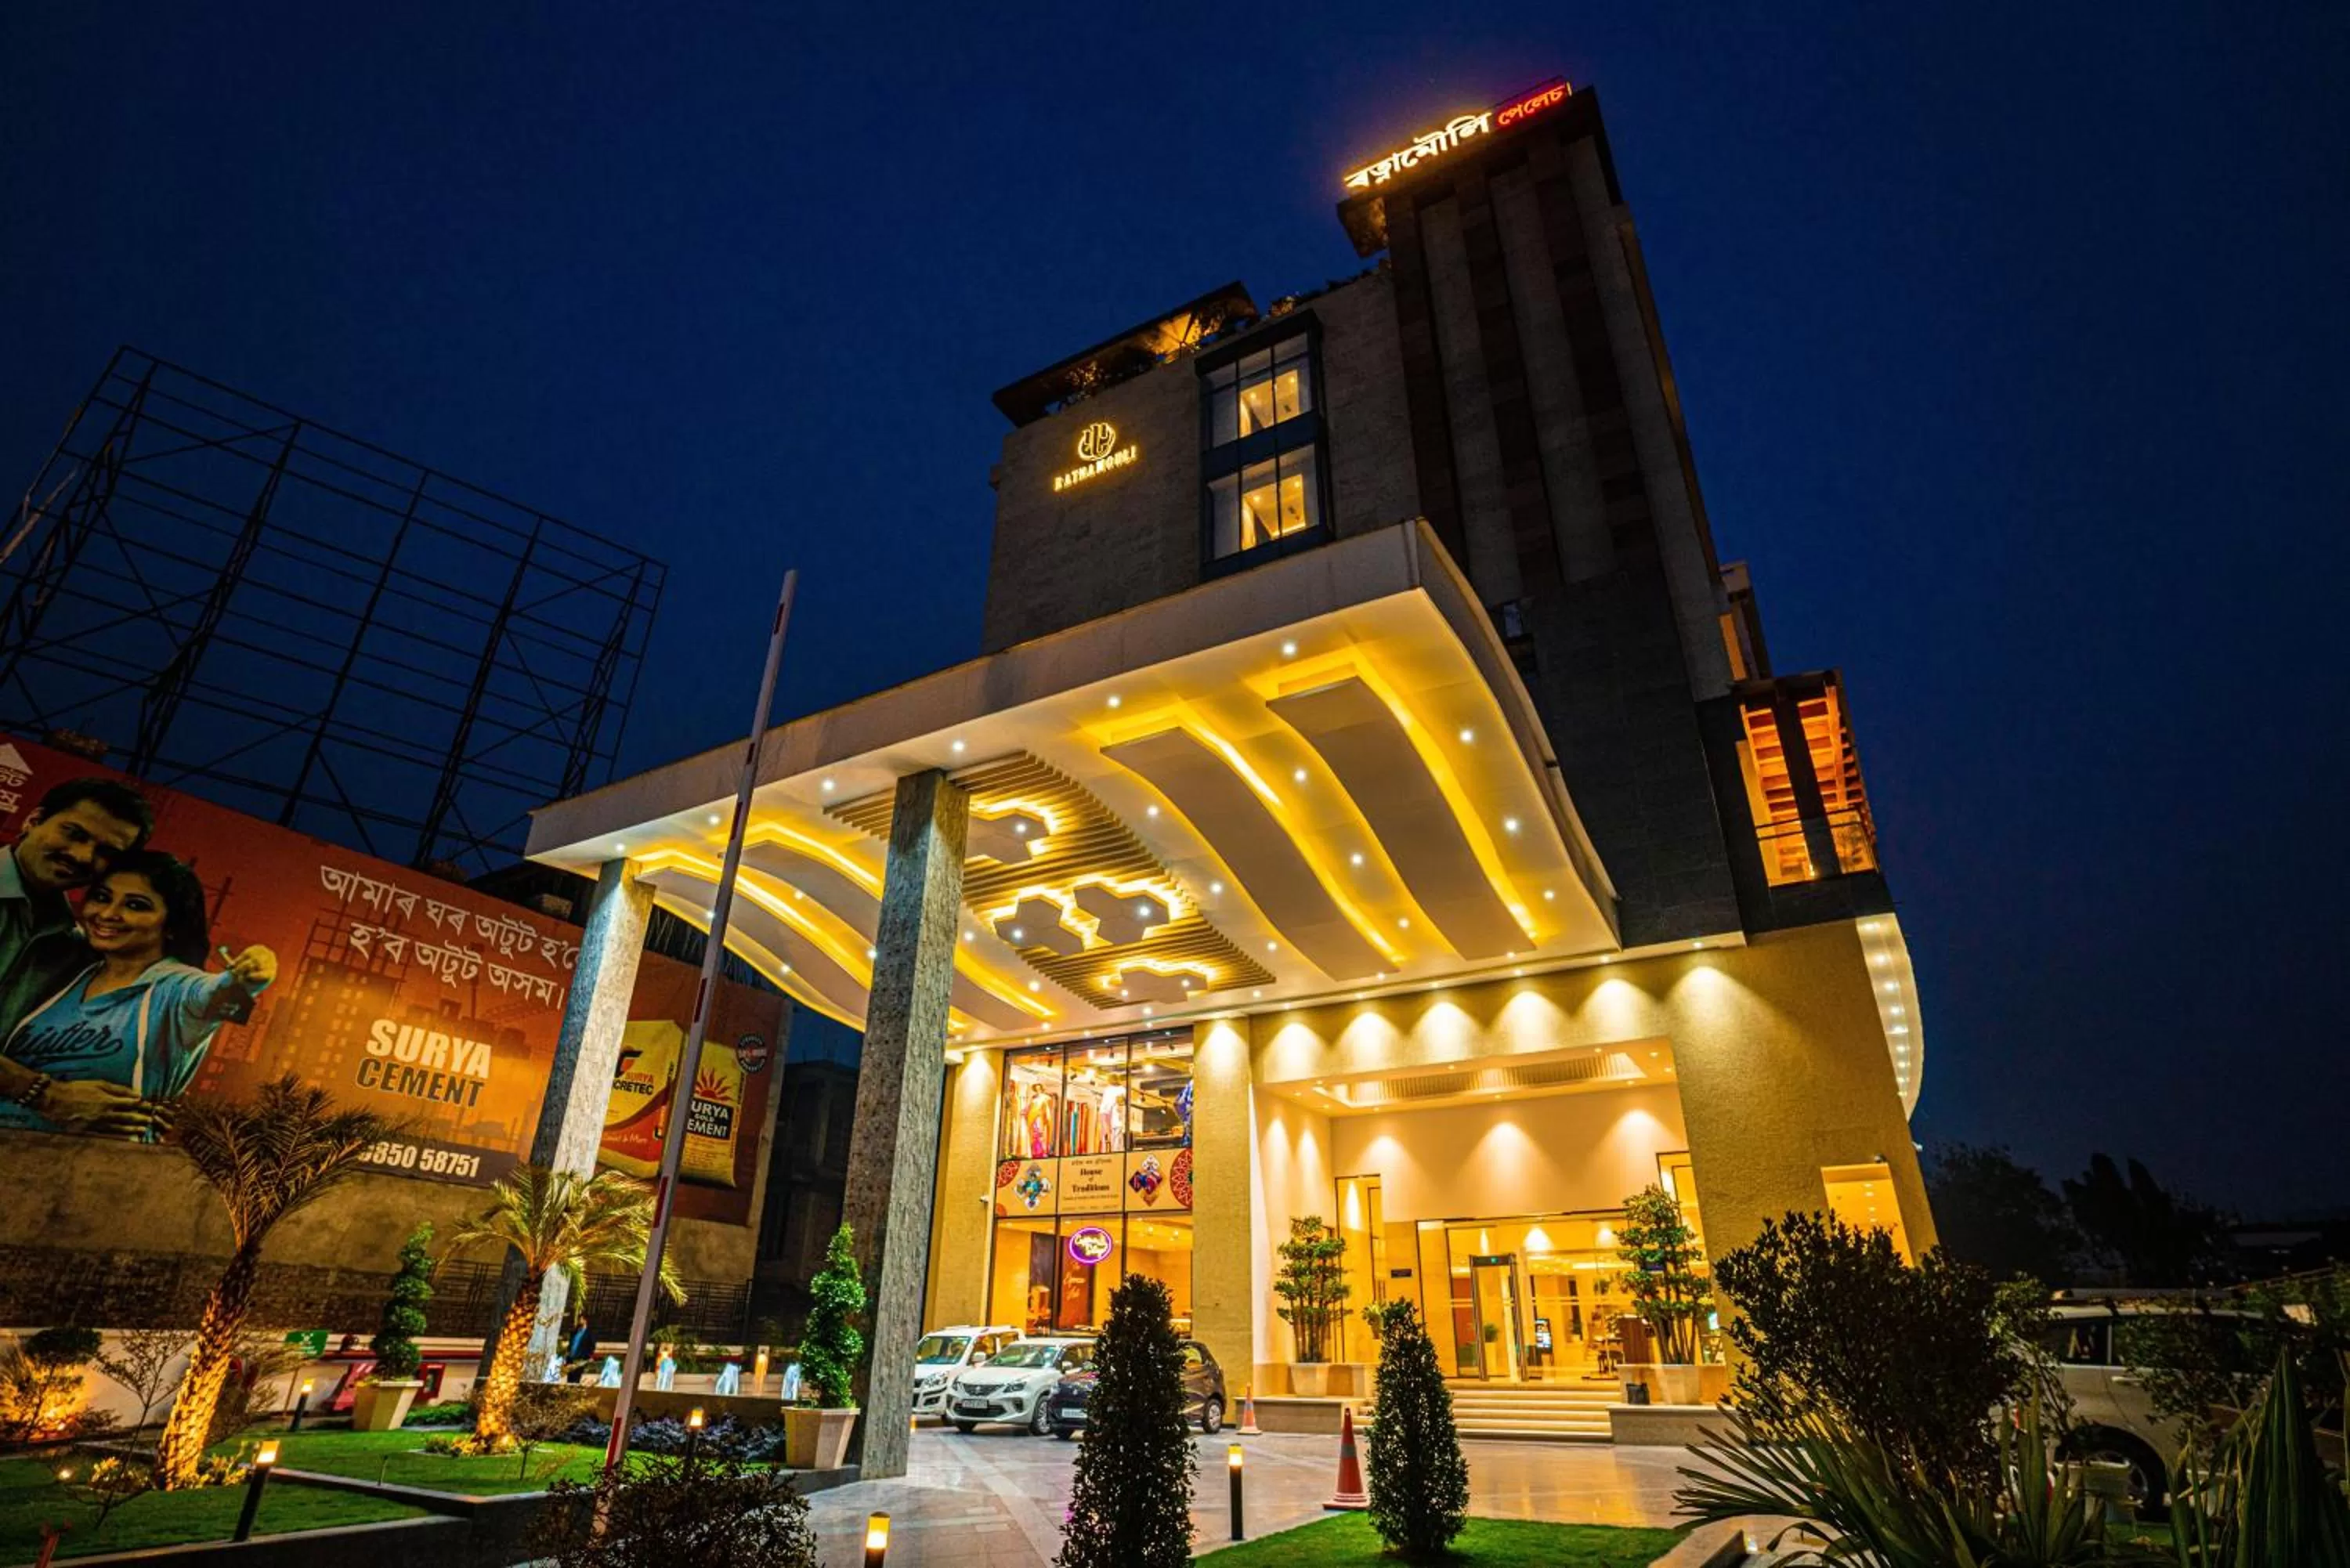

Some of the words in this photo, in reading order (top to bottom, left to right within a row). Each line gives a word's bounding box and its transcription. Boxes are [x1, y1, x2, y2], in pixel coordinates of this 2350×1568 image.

[320, 865, 421, 922] আমাৰ
[425, 898, 471, 937] ঘৰ
[366, 1019, 492, 1079] SURYA
[356, 1057, 486, 1109] CEMENT
[613, 1078, 654, 1096] CRETEC
[691, 1100, 729, 1120] URYA
[687, 1118, 728, 1138] EMENT
[419, 1148, 480, 1177] 58751
